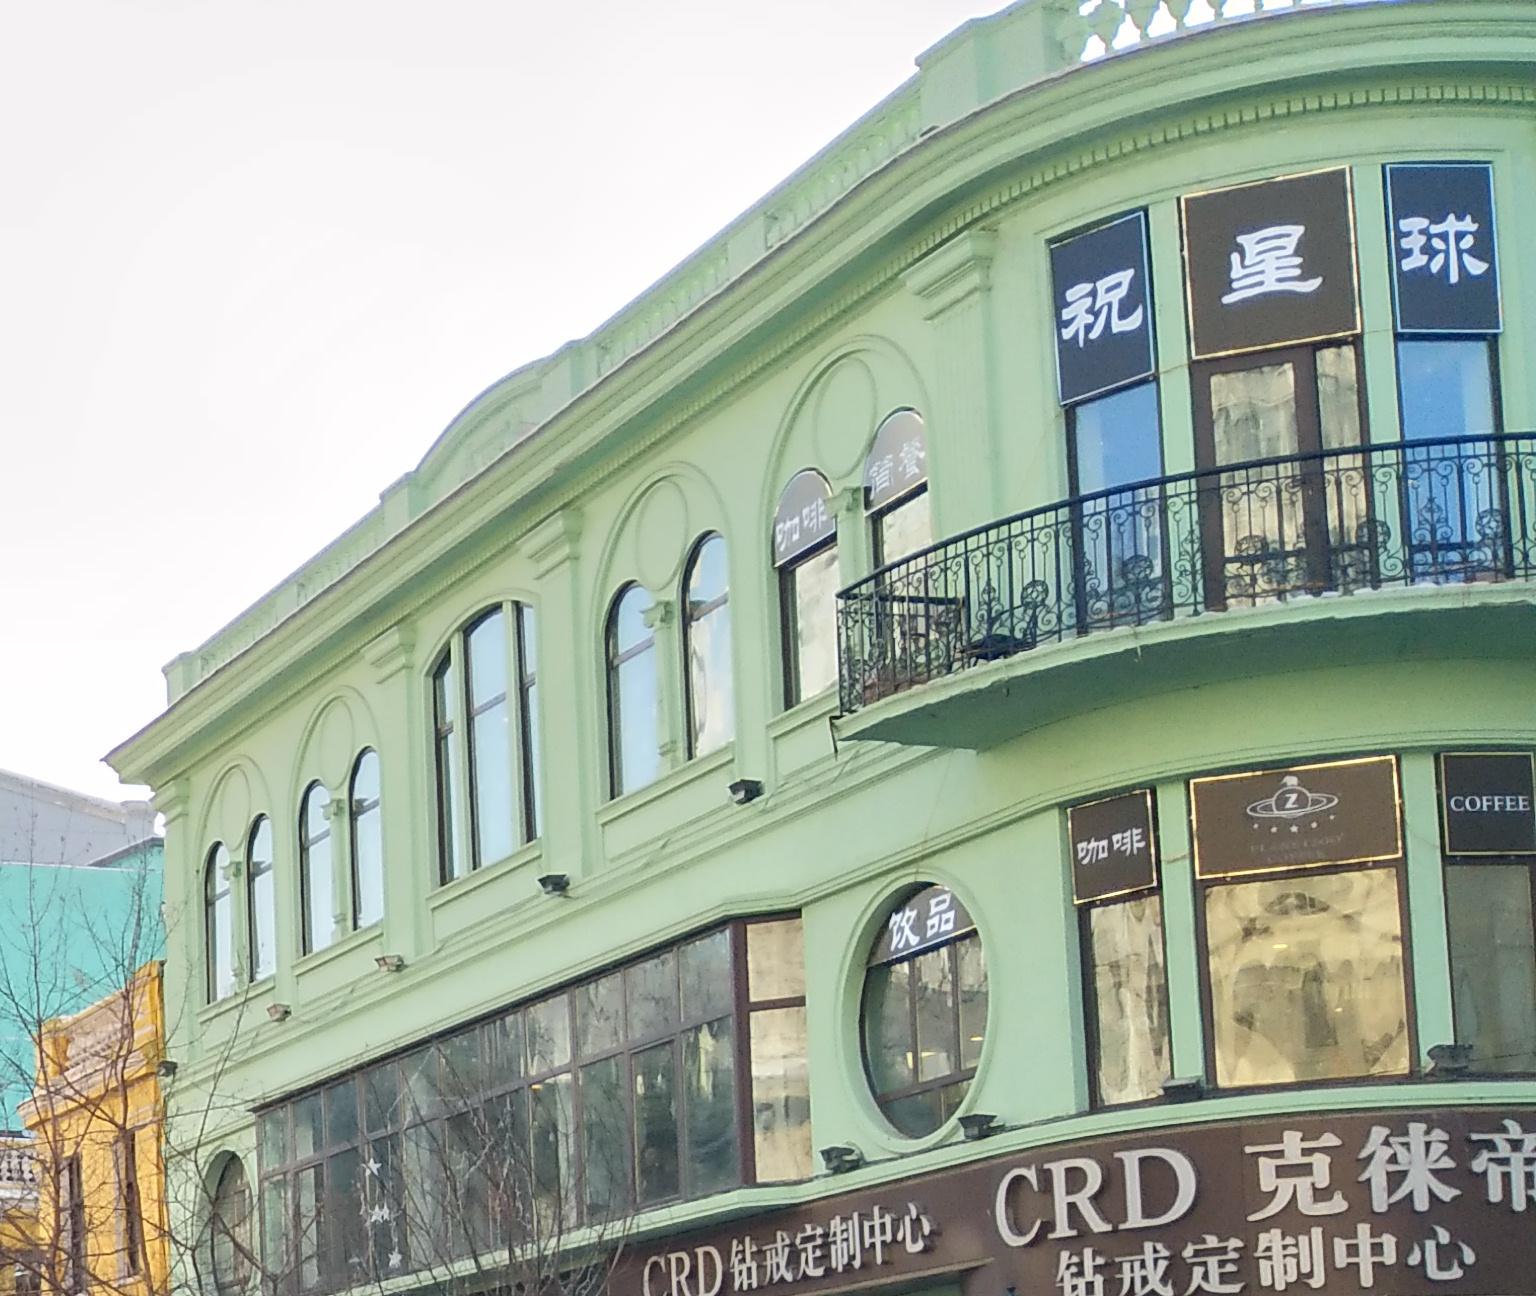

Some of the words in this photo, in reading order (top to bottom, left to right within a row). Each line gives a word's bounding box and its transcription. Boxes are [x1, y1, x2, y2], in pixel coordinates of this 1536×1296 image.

[1221, 224, 1323, 304] 星
[1398, 212, 1490, 284] 球
[1061, 268, 1144, 348] 祝
[775, 497, 827, 550] 咖啡
[1449, 793, 1531, 814] COFFEE
[1077, 827, 1147, 865] 咖啡
[889, 892, 957, 951] 饮品
[995, 1147, 1198, 1247] CRD
[730, 1202, 930, 1293] 钻戒定制中心
